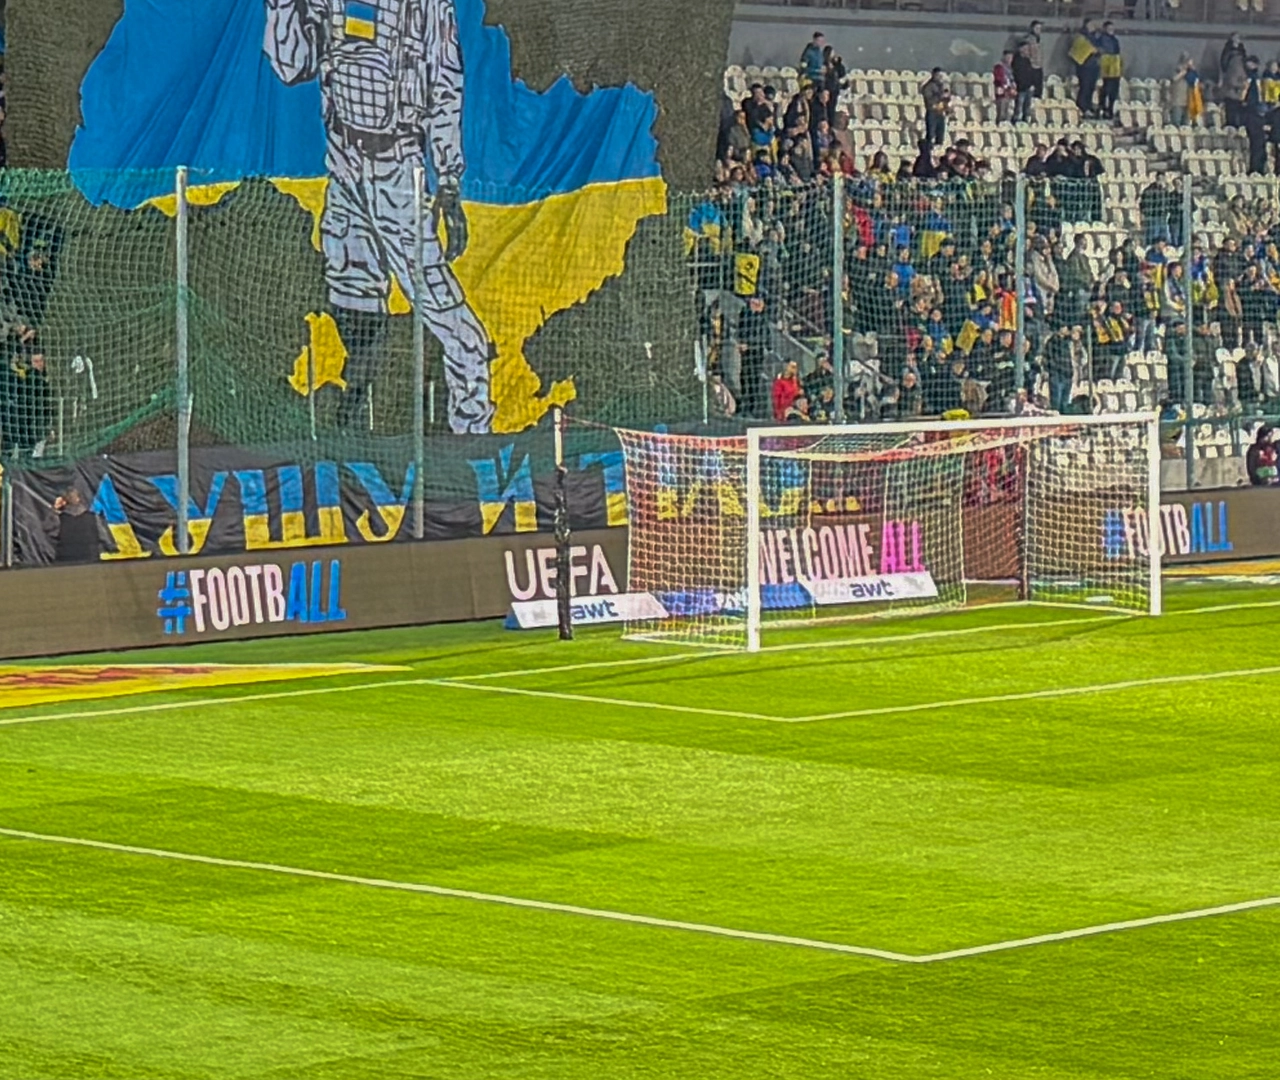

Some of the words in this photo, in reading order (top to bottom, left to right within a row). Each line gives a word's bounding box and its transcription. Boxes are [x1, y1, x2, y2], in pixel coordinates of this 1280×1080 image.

[504, 544, 619, 601] UEFA
[881, 520, 926, 574] ALL
[157, 559, 347, 635] #FOOTBALL
[571, 599, 620, 620] awt
[850, 579, 896, 598] awt
